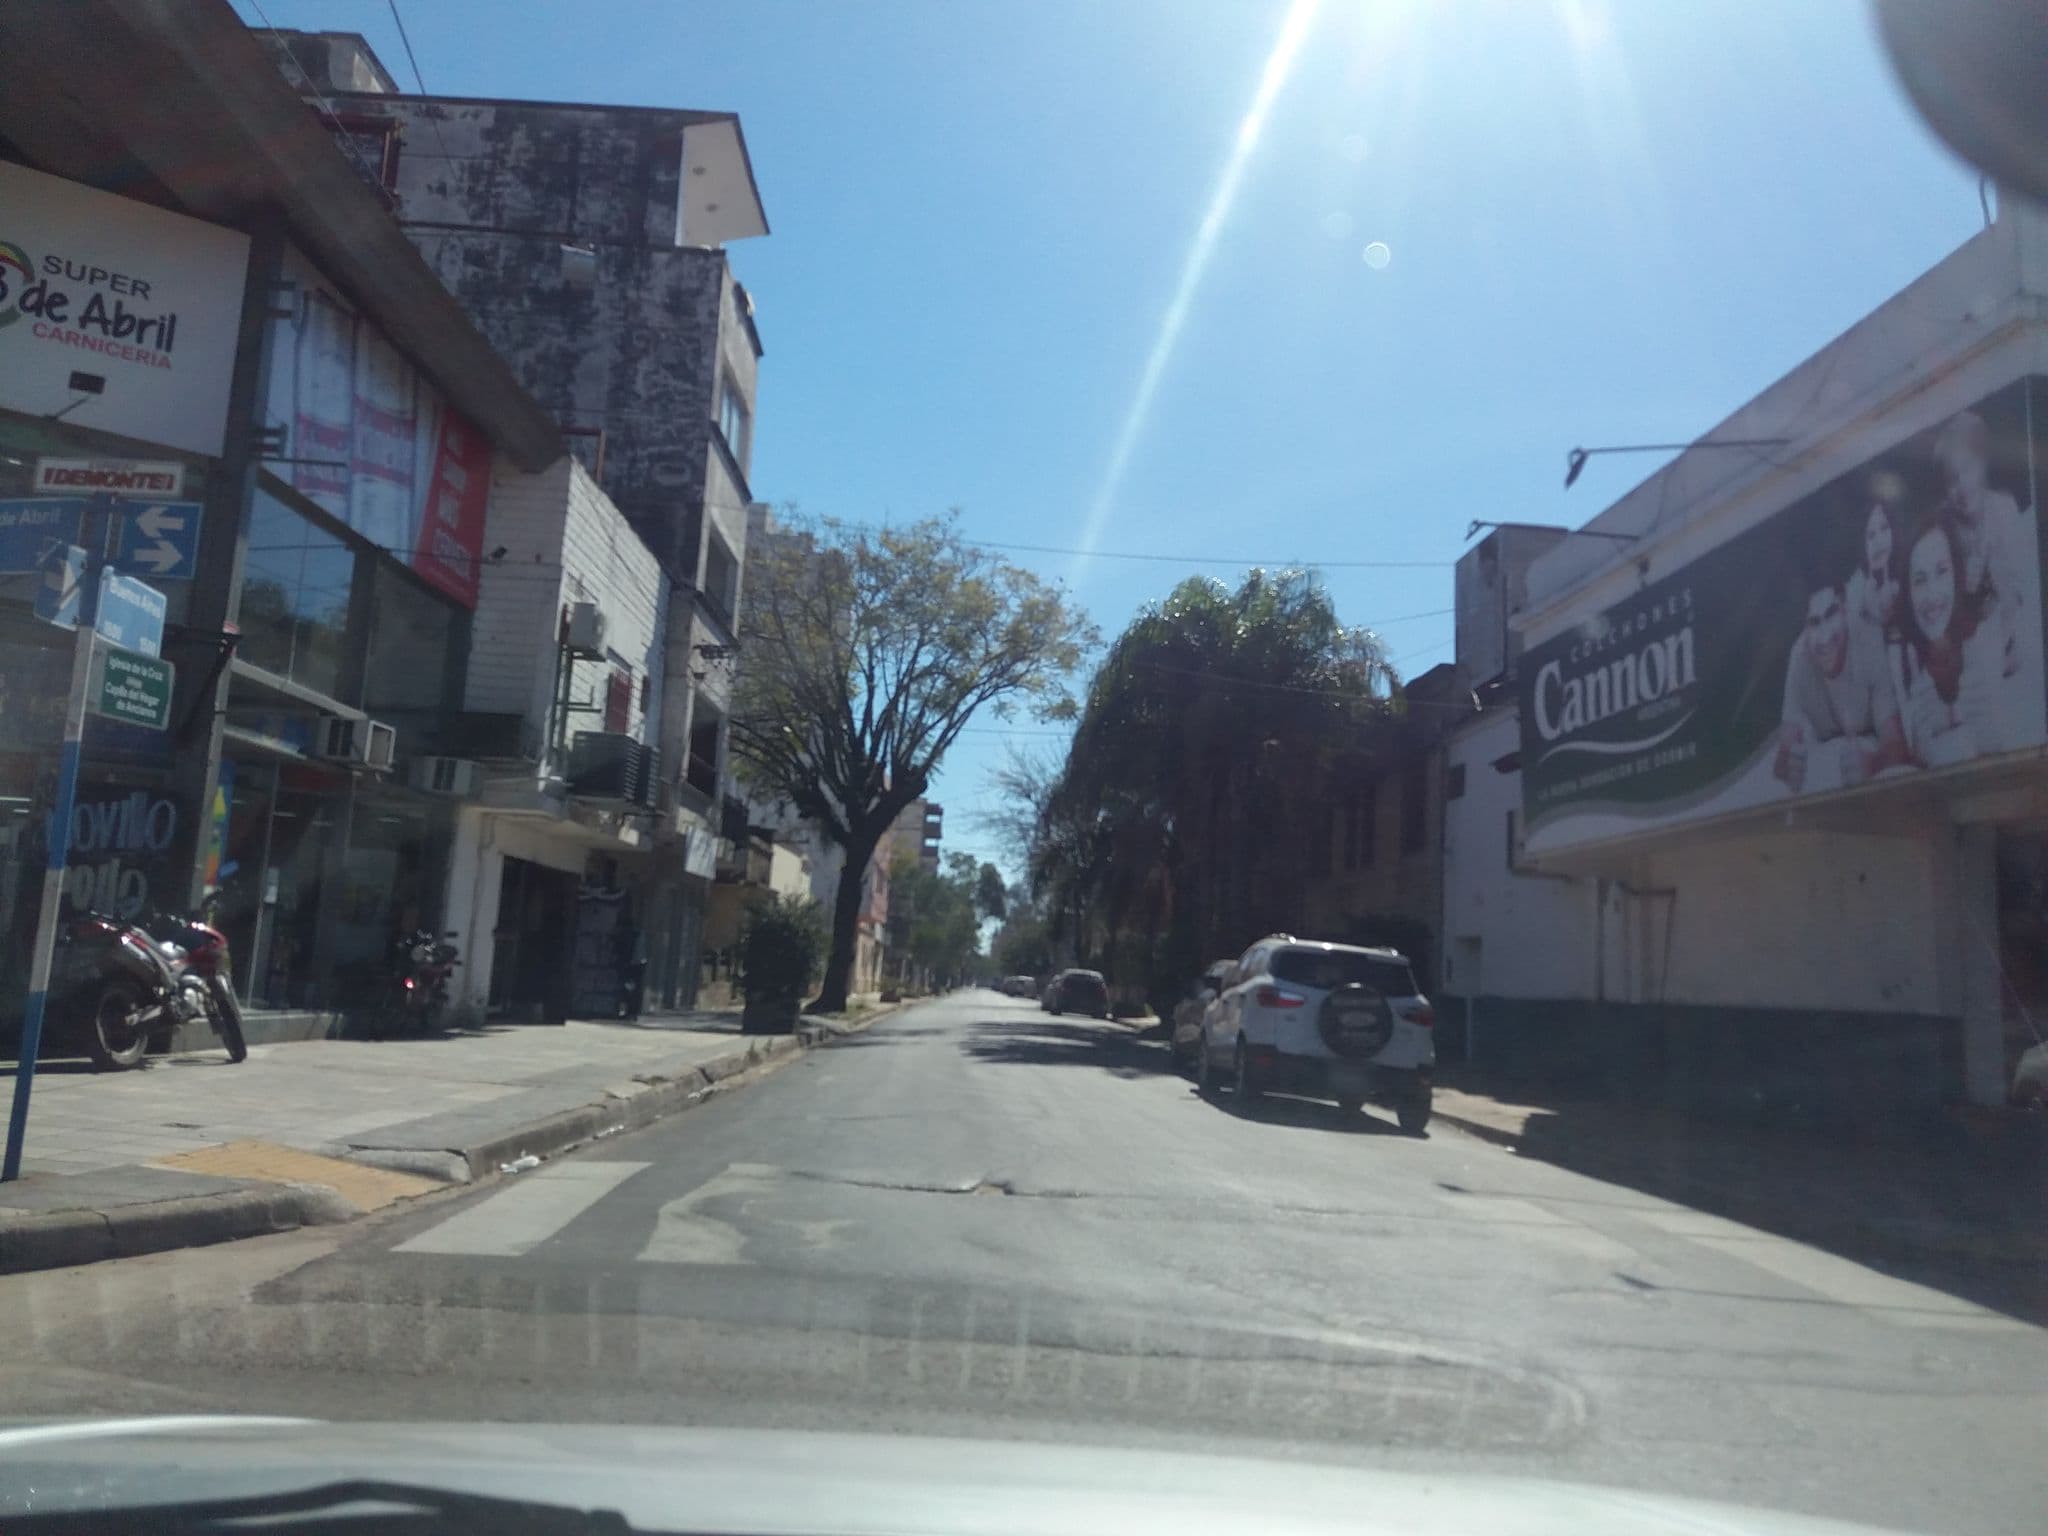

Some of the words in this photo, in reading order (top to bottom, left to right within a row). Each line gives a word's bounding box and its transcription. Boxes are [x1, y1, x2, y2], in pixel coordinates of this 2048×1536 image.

[43, 255, 151, 300] SUPER
[19, 280, 68, 322] de
[78, 292, 177, 353] Abril
[32, 322, 173, 369] CARNICERIA
[1570, 587, 1692, 664] COLCHONES
[1534, 627, 1697, 741] Cannon
